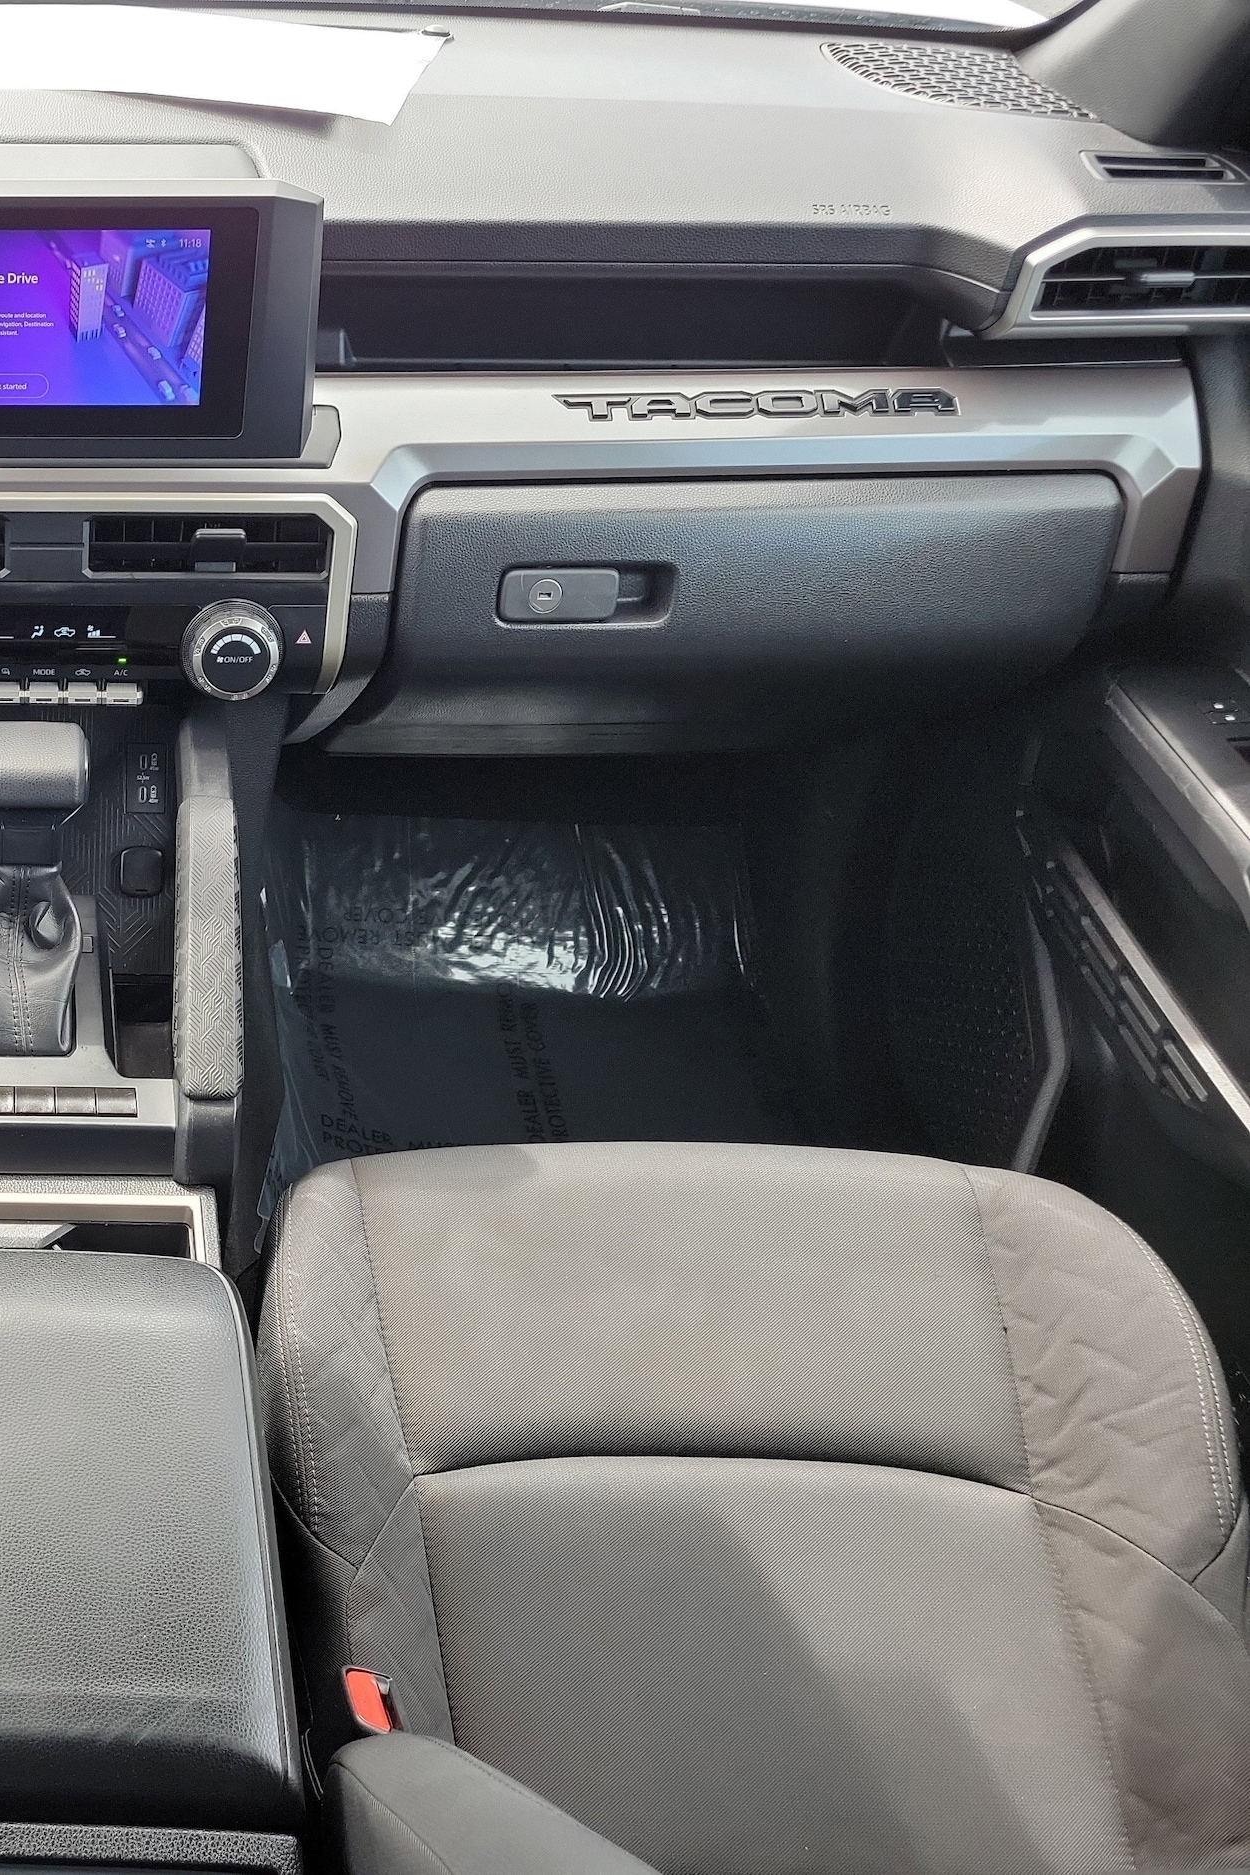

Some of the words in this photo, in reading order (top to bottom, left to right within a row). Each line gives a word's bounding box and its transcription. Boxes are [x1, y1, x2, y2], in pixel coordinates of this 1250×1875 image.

[179, 238, 202, 248] 11:18
[7, 272, 39, 284] Drive
[3, 382, 27, 391] started
[550, 387, 961, 422] TACOMA
[223, 656, 254, 664] ON/OFF
[32, 668, 56, 676] MODE
[113, 669, 129, 677] A/C
[503, 1039, 531, 1080] MUST
[532, 1057, 569, 1141] ROTECTIVE
[320, 1113, 394, 1147] DEALER
